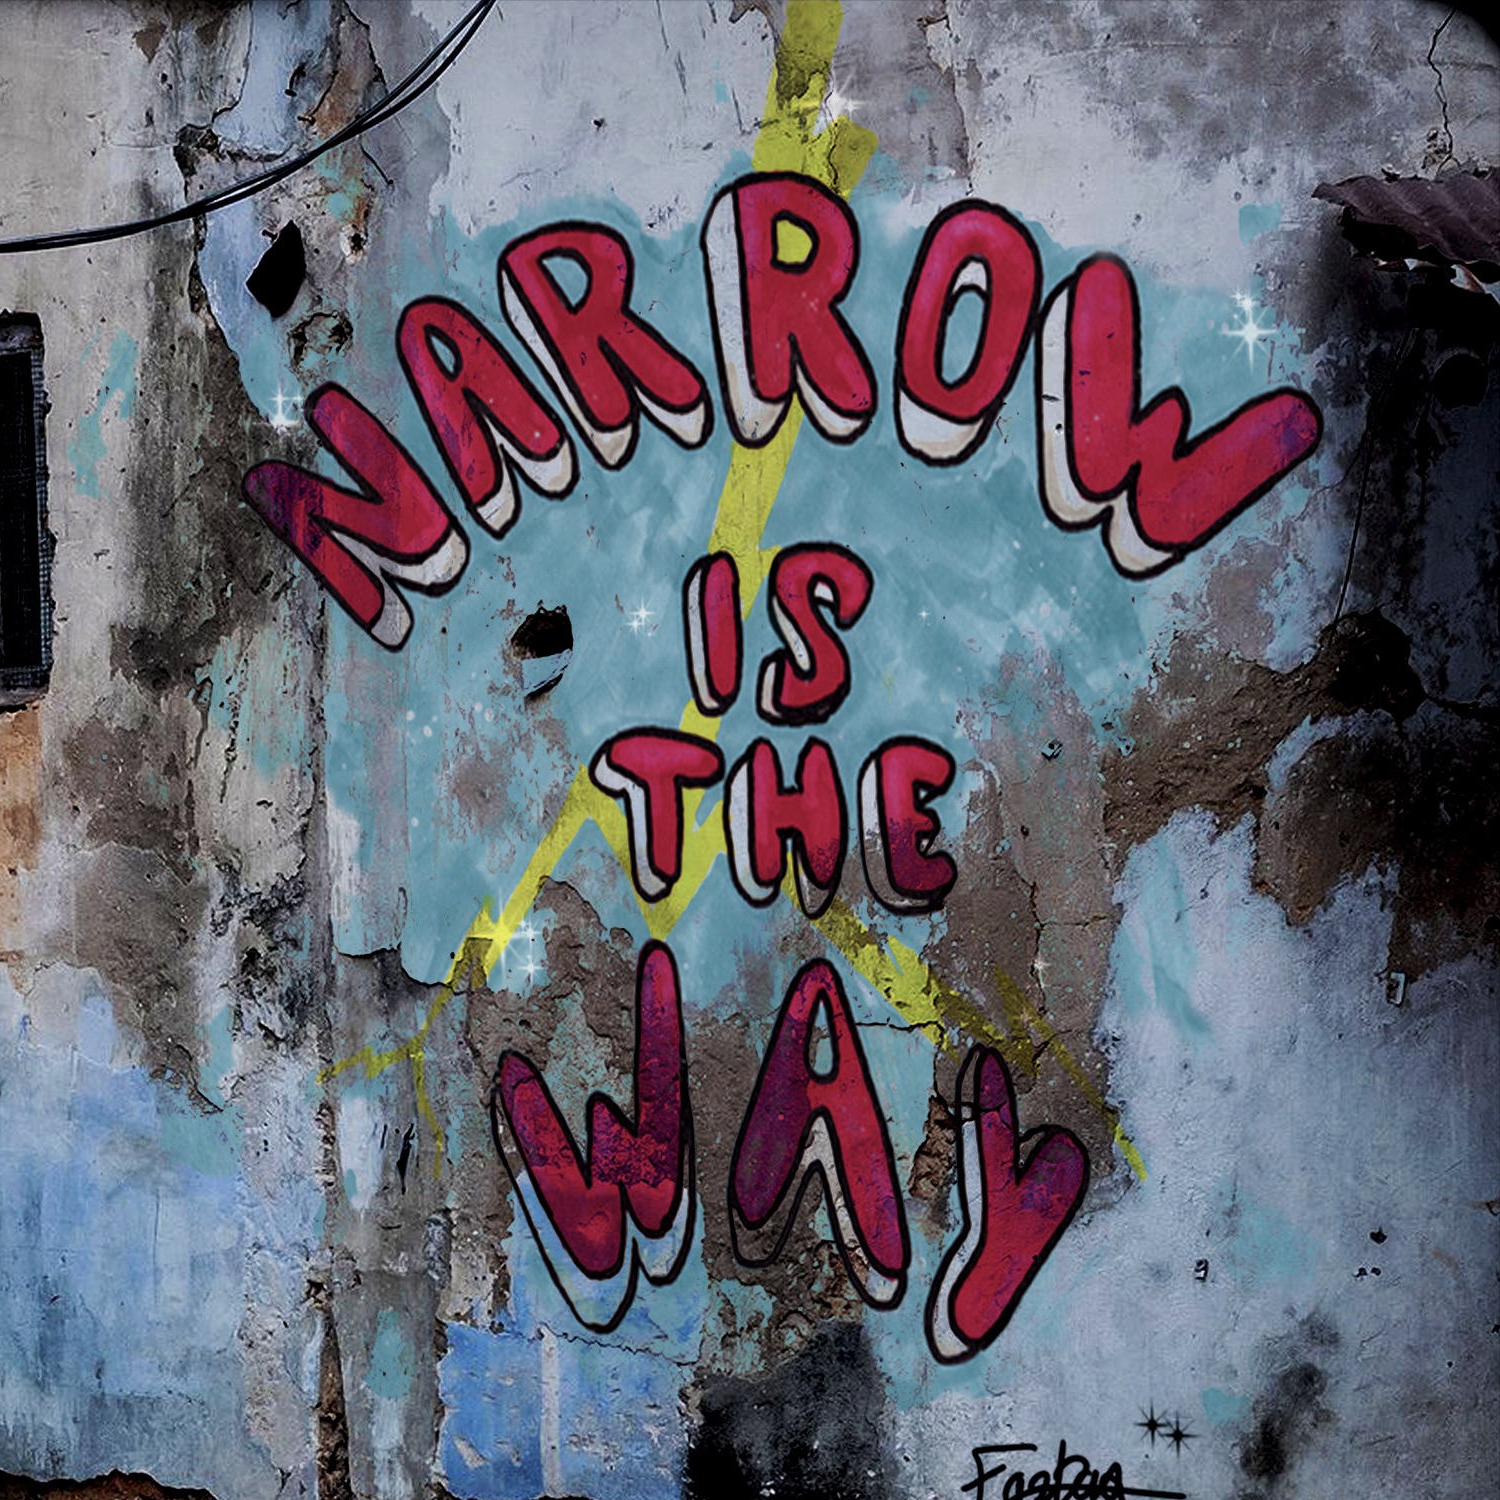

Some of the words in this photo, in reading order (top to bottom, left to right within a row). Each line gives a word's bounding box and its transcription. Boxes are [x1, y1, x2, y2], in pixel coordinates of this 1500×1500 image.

[242, 171, 1322, 651] NARROW
[682, 541, 874, 725] IS
[589, 725, 956, 919] THE
[491, 938, 1090, 1365] WAY
